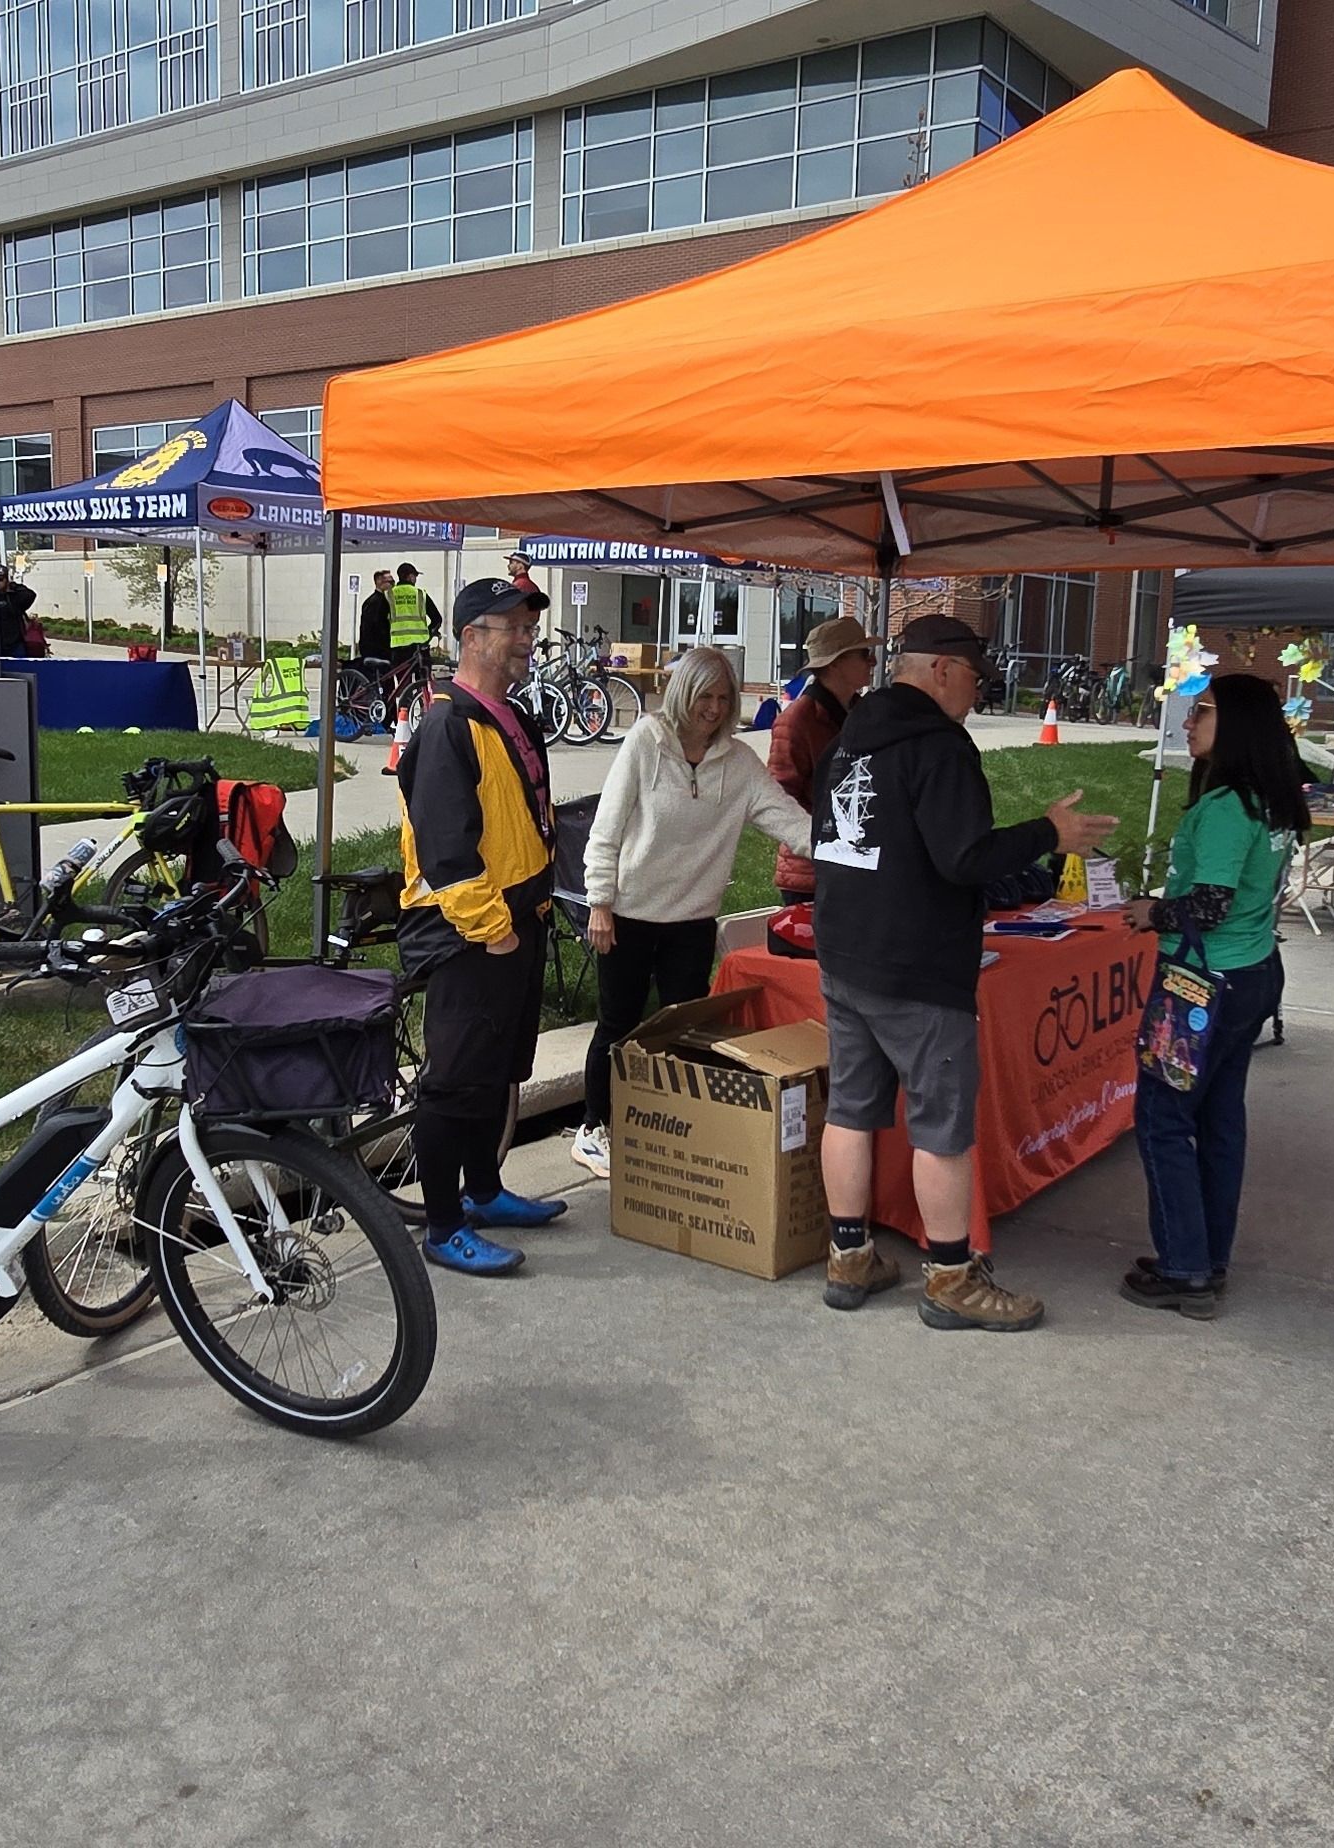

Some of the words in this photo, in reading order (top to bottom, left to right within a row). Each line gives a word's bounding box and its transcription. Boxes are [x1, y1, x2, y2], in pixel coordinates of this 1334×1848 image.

[2, 498, 87, 522] MOUNTAIN
[90, 496, 132, 520] BIKE
[134, 493, 187, 519] TEAM
[258, 504, 351, 529] LANCASR
[356, 513, 437, 538] COMPOSITE
[526, 542, 605, 560] MOUNTAIN
[609, 542, 648, 559] BIKE
[1092, 951, 1144, 1034] LBK
[624, 1105, 693, 1138] ProRider
[688, 1214, 733, 1240] SEATTLE
[734, 1225, 756, 1246] USA
